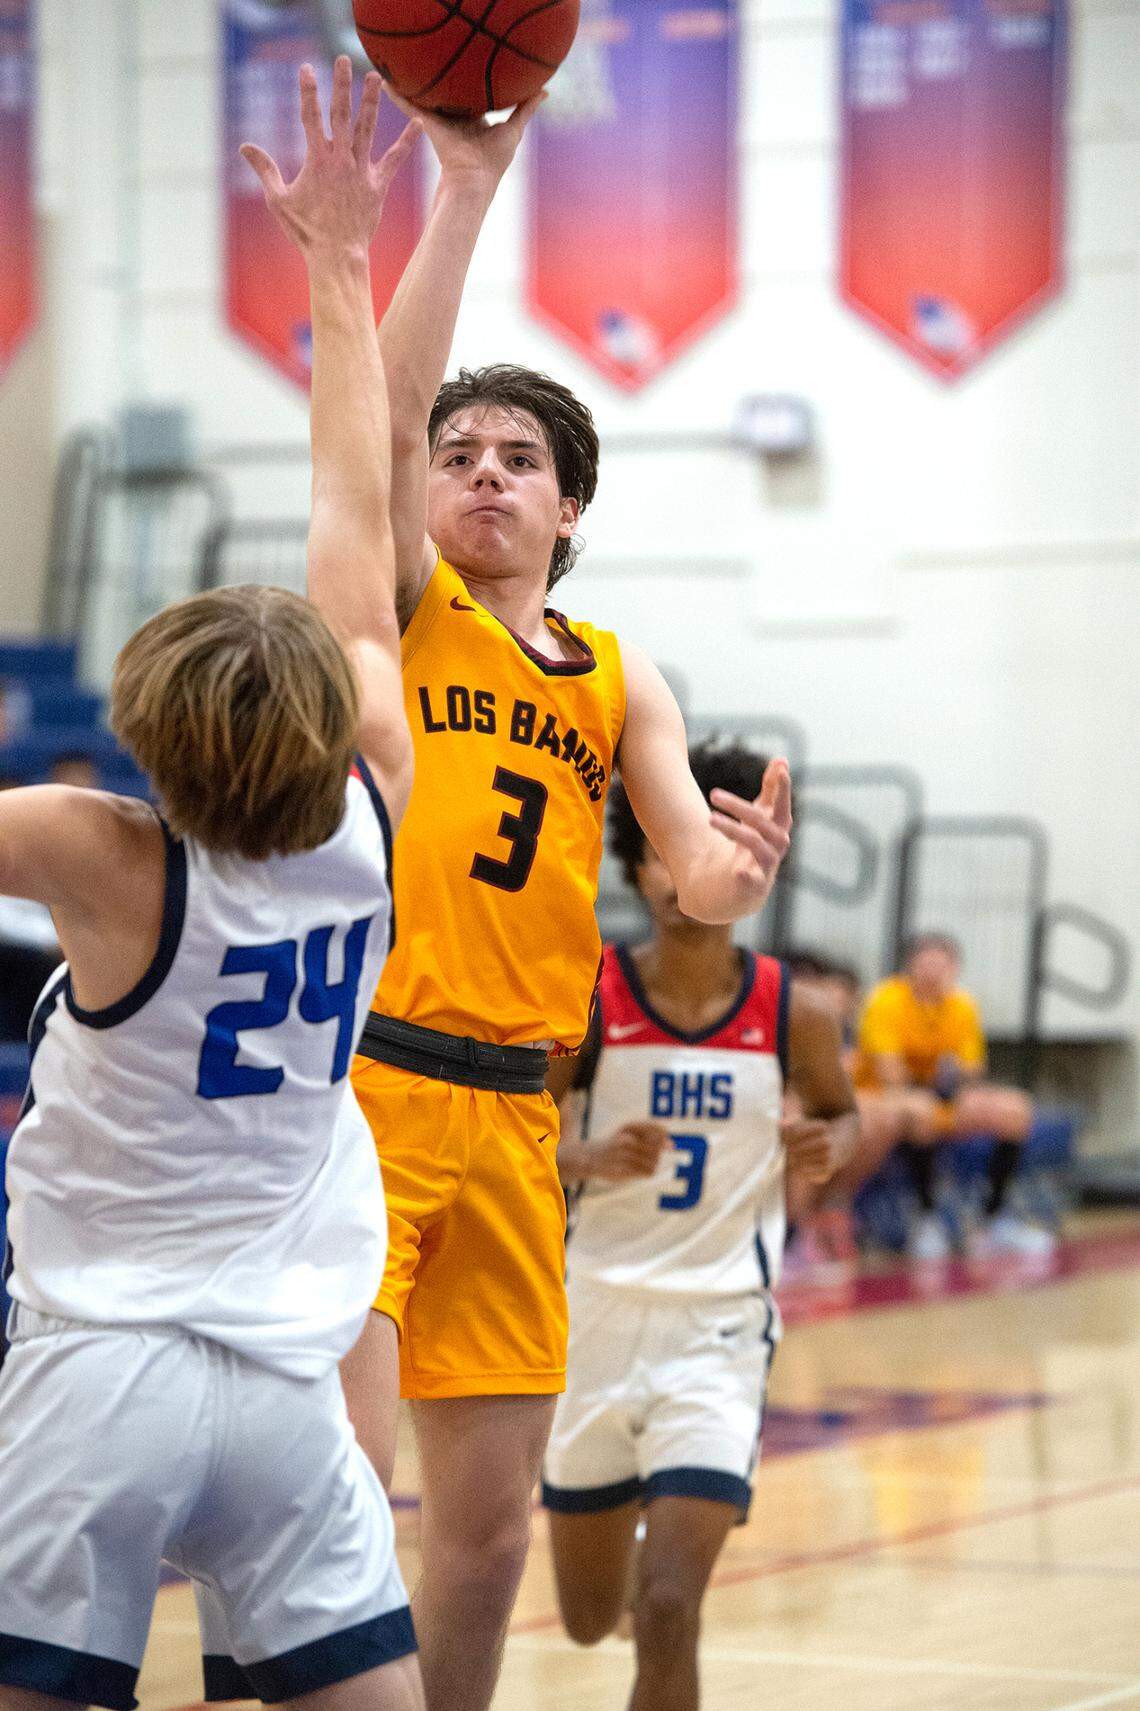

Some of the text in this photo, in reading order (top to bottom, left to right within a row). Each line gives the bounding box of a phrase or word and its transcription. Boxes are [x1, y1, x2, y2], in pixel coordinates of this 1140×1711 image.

[418, 685, 497, 735] LOS
[468, 765, 549, 893] 3
[196, 914, 374, 1100] 24
[651, 1070, 735, 1120] BHS
[658, 1133, 709, 1212] 3
